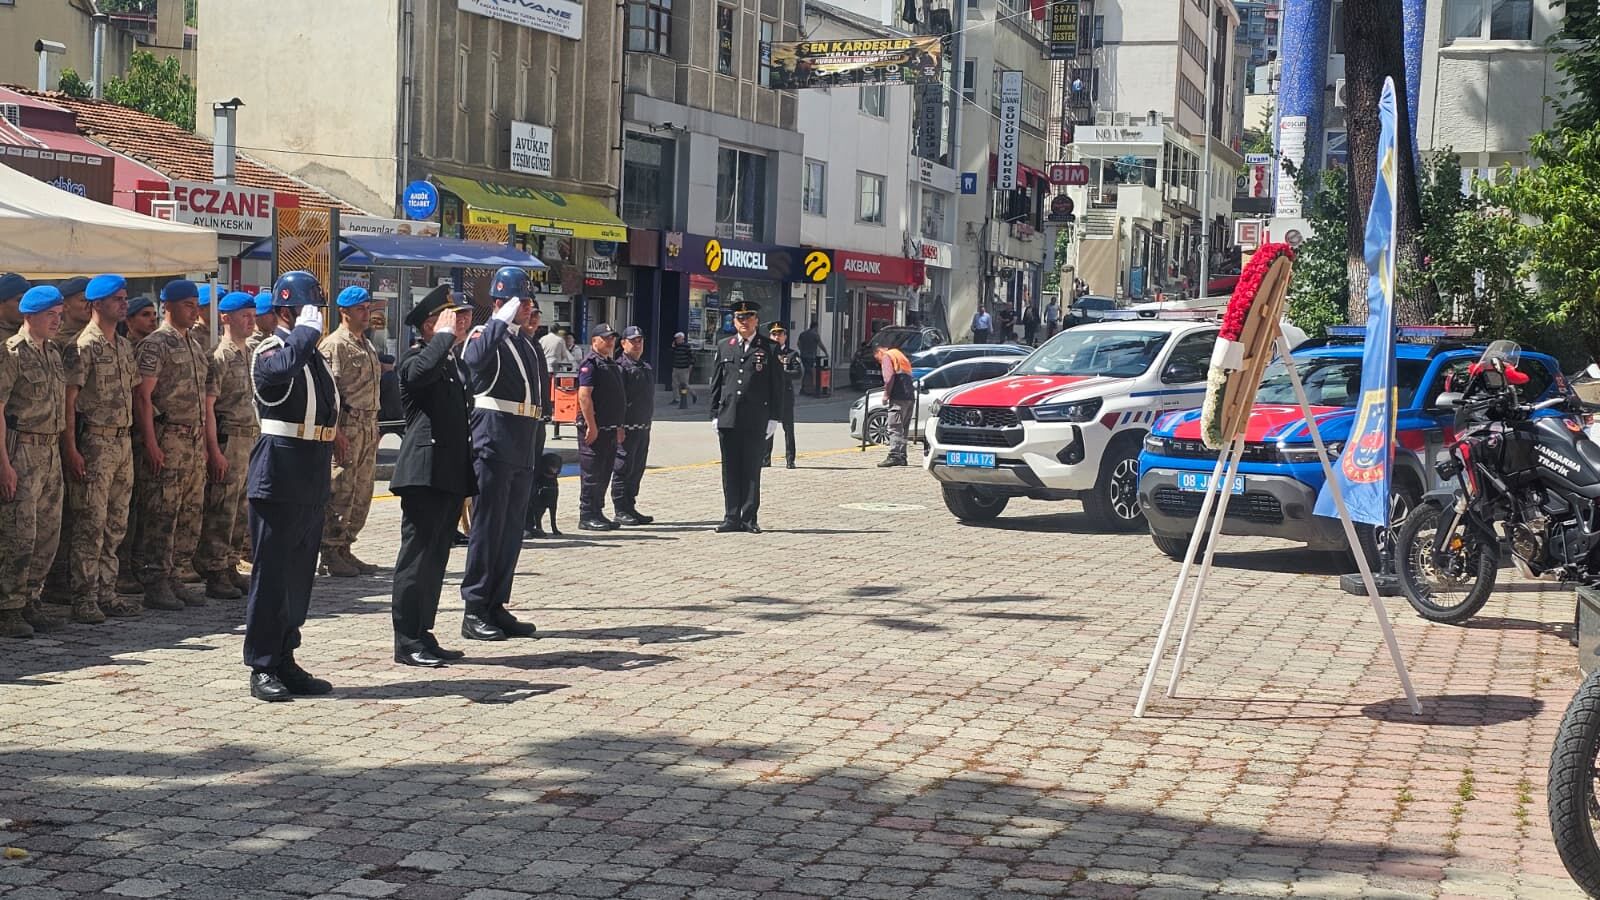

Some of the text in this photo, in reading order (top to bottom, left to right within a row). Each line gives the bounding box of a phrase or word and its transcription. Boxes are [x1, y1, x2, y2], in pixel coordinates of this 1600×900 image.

[515, 137, 549, 154] AVUKAT
[530, 153, 551, 172] GÜNER
[1053, 165, 1084, 180] BİM
[174, 186, 270, 218] ECZANE
[193, 216, 253, 231] AYLİN KESKİN
[1242, 227, 1255, 241] E
[722, 247, 768, 270] TURKCELL
[844, 258, 881, 274] AKBANK
[950, 452, 994, 465] 08 JAA 173
[1534, 444, 1581, 472] JANDARMA
[1537, 455, 1569, 477] TRAFİK
[1182, 474, 1196, 487] 08
